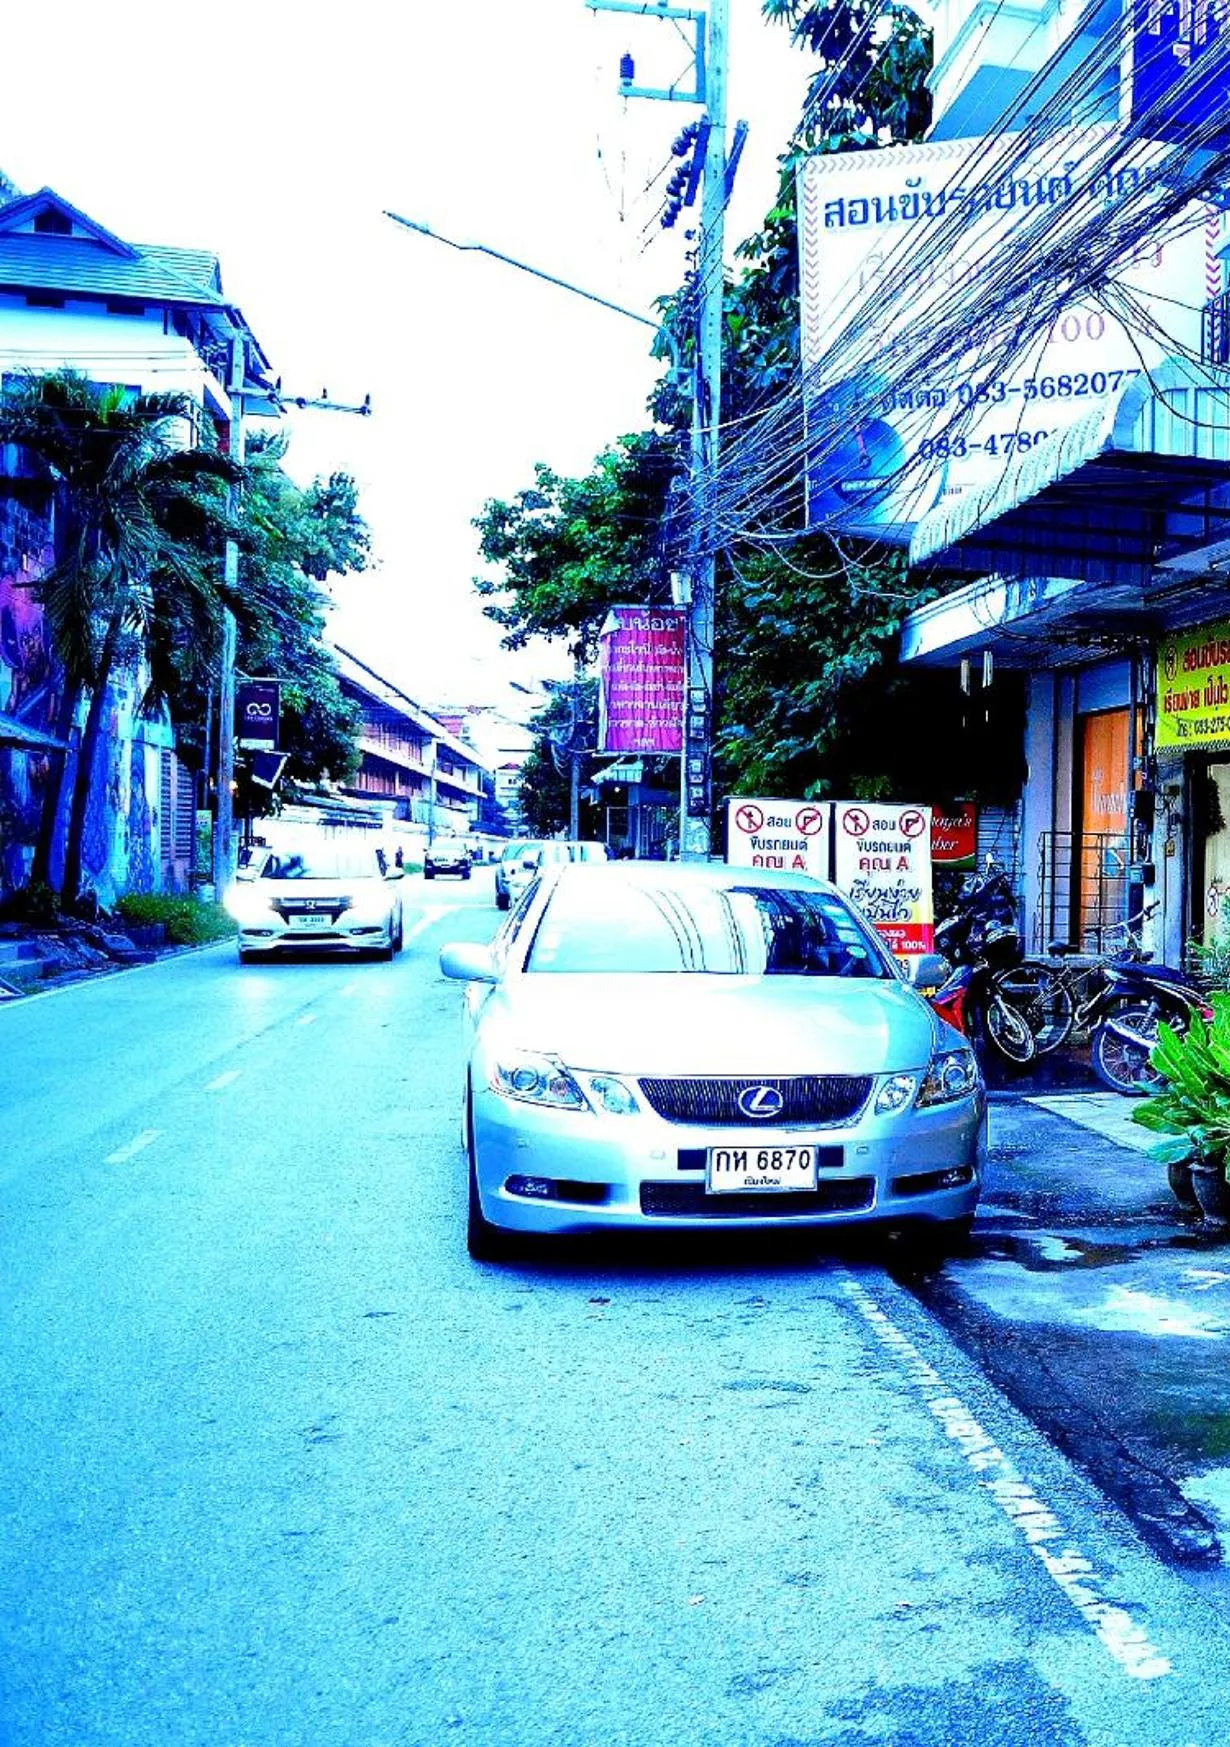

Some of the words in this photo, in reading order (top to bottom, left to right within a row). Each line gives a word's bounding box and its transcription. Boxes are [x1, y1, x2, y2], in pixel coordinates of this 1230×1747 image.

[766, 815, 792, 828] สอน
[872, 819, 897, 831] สอน
[859, 857, 891, 877] คุณ
[895, 855, 910, 871] A
[757, 1149, 811, 1171] 6870
